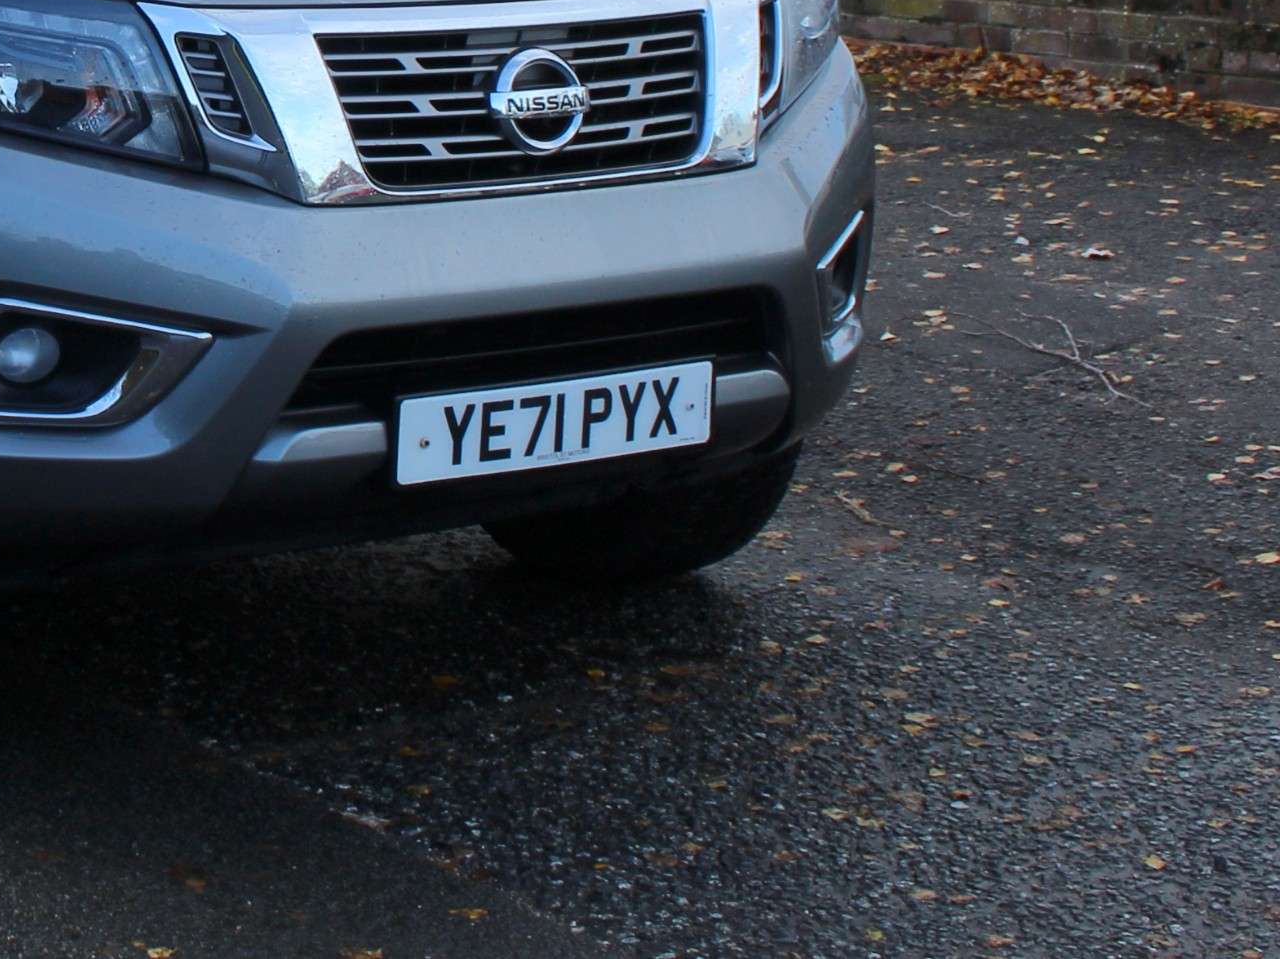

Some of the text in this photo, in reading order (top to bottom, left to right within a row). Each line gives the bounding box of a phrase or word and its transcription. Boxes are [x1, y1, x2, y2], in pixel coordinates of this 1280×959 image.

[506, 93, 585, 113] NISSAN
[444, 392, 566, 465] YE71
[581, 376, 680, 449] PYX
